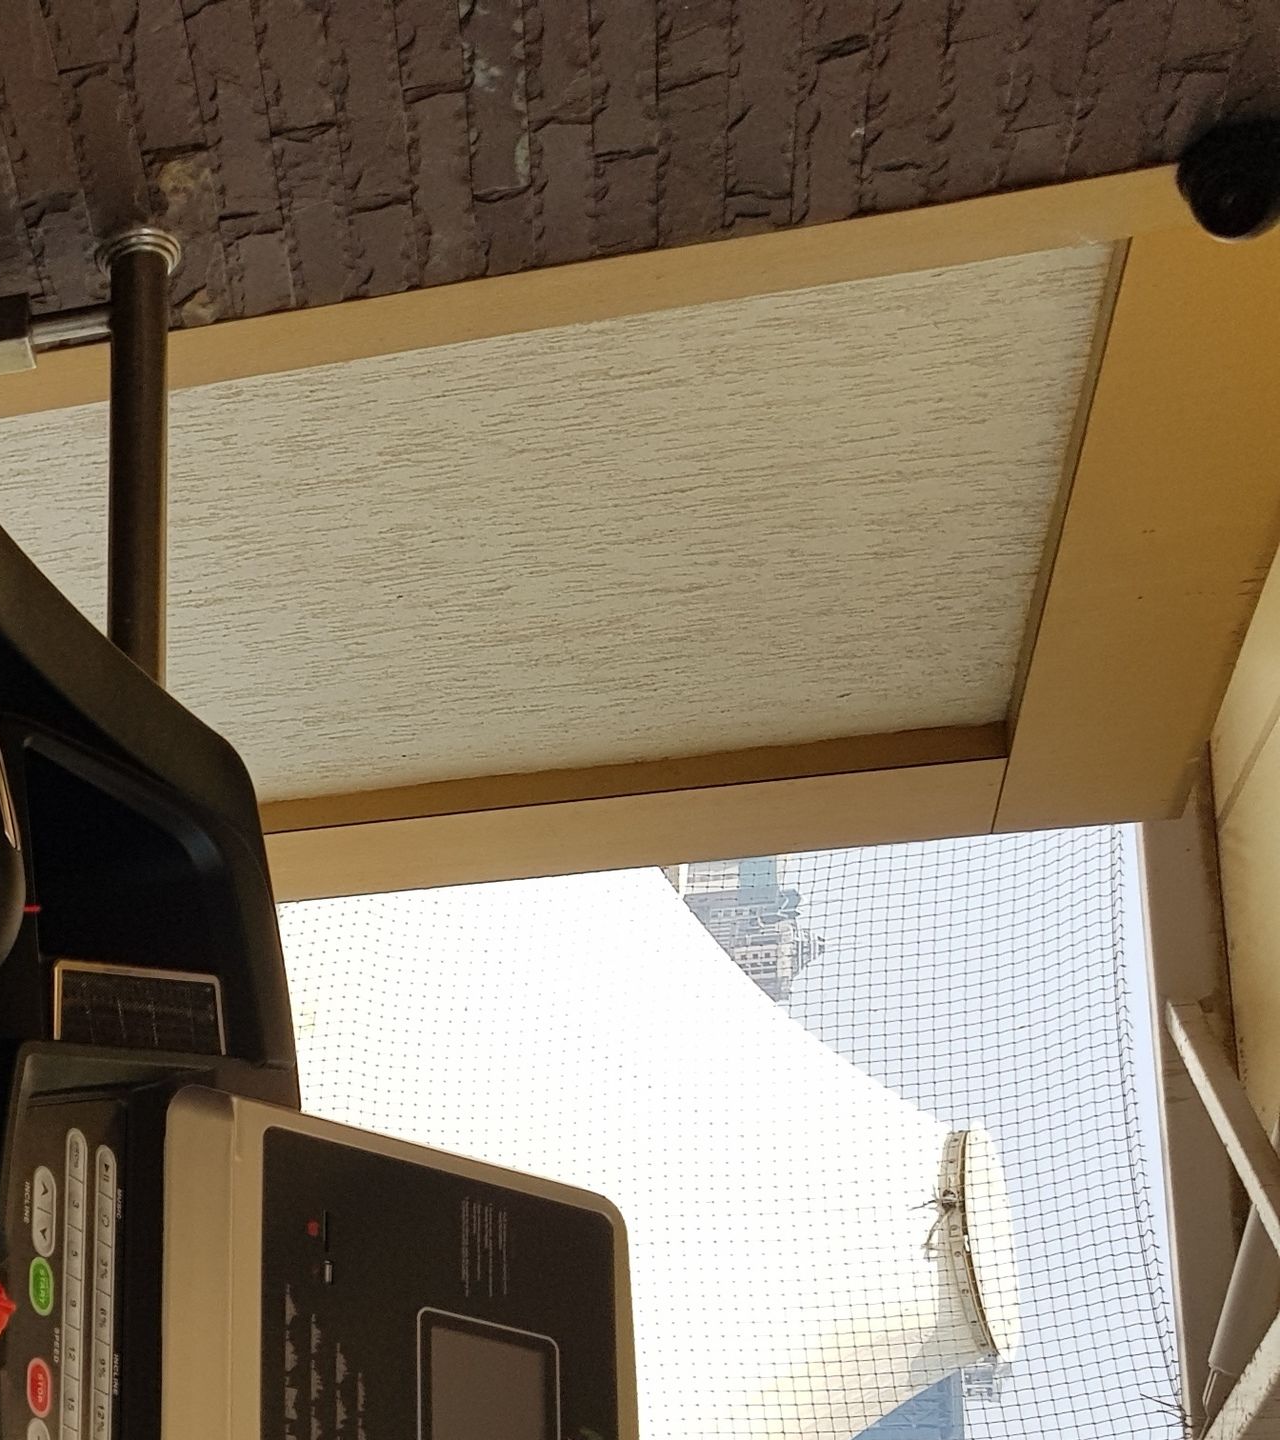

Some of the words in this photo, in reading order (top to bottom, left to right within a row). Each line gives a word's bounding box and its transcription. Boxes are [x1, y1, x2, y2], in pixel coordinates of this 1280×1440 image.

[22, 1181, 31, 1224] INCLINE
[72, 1200, 80, 1209] 3
[39, 1268, 48, 1304] START
[52, 1327, 60, 1364] SPEED
[68, 1346, 76, 1362] 12
[36, 1372, 44, 1404] STOP
[112, 1353, 120, 1397] INCLINE
[66, 1397, 75, 1412] 15
[95, 1404, 105, 1432] 12%
